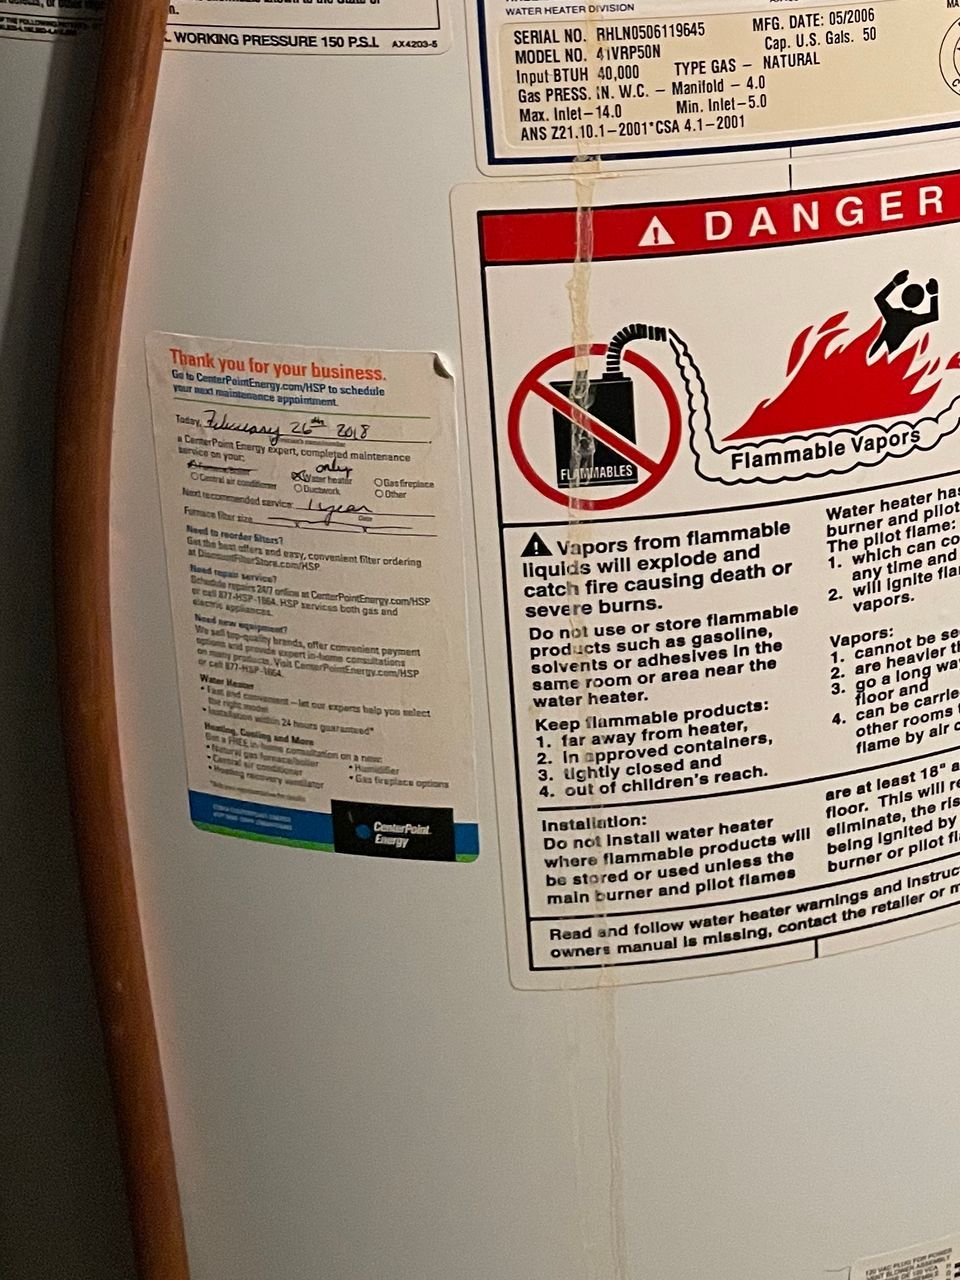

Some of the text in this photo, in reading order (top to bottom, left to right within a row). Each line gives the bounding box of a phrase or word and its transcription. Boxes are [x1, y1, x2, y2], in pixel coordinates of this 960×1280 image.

[505, 3, 635, 16] WATER HEATER DIVISION
[752, 7, 875, 32] MFG. DATE: 05/2006
[173, 31, 239, 45] WORKING
[242, 34, 318, 47] PRESSURE
[321, 36, 345, 48] 150
[514, 22, 705, 45] SERIAL NO. RHLN0506119645
[765, 26, 876, 52] Cap. U.S. Gals. 50
[515, 49, 561, 64] MODEL
[565, 48, 587, 62] NO.
[674, 51, 820, 76] TYPE GAS NATURAL
[516, 64, 639, 87] Input BTUH 40,000
[672, 75, 765, 95] Manifold 4.0
[518, 89, 541, 103] Gas
[545, 86, 591, 102] PRESS.
[618, 83, 649, 98] W.C.
[519, 108, 549, 122] Max.
[676, 100, 703, 114] Min.
[521, 126, 547, 141] ANS
[704, 185, 945, 241] DANGER
[169, 348, 386, 381] Thank you for your business.
[731, 430, 921, 470] Flammable Vapors
[556, 520, 791, 558] Vapors from flammable
[373, 821, 432, 835] CenterPoint
[374, 834, 410, 849] Energy
